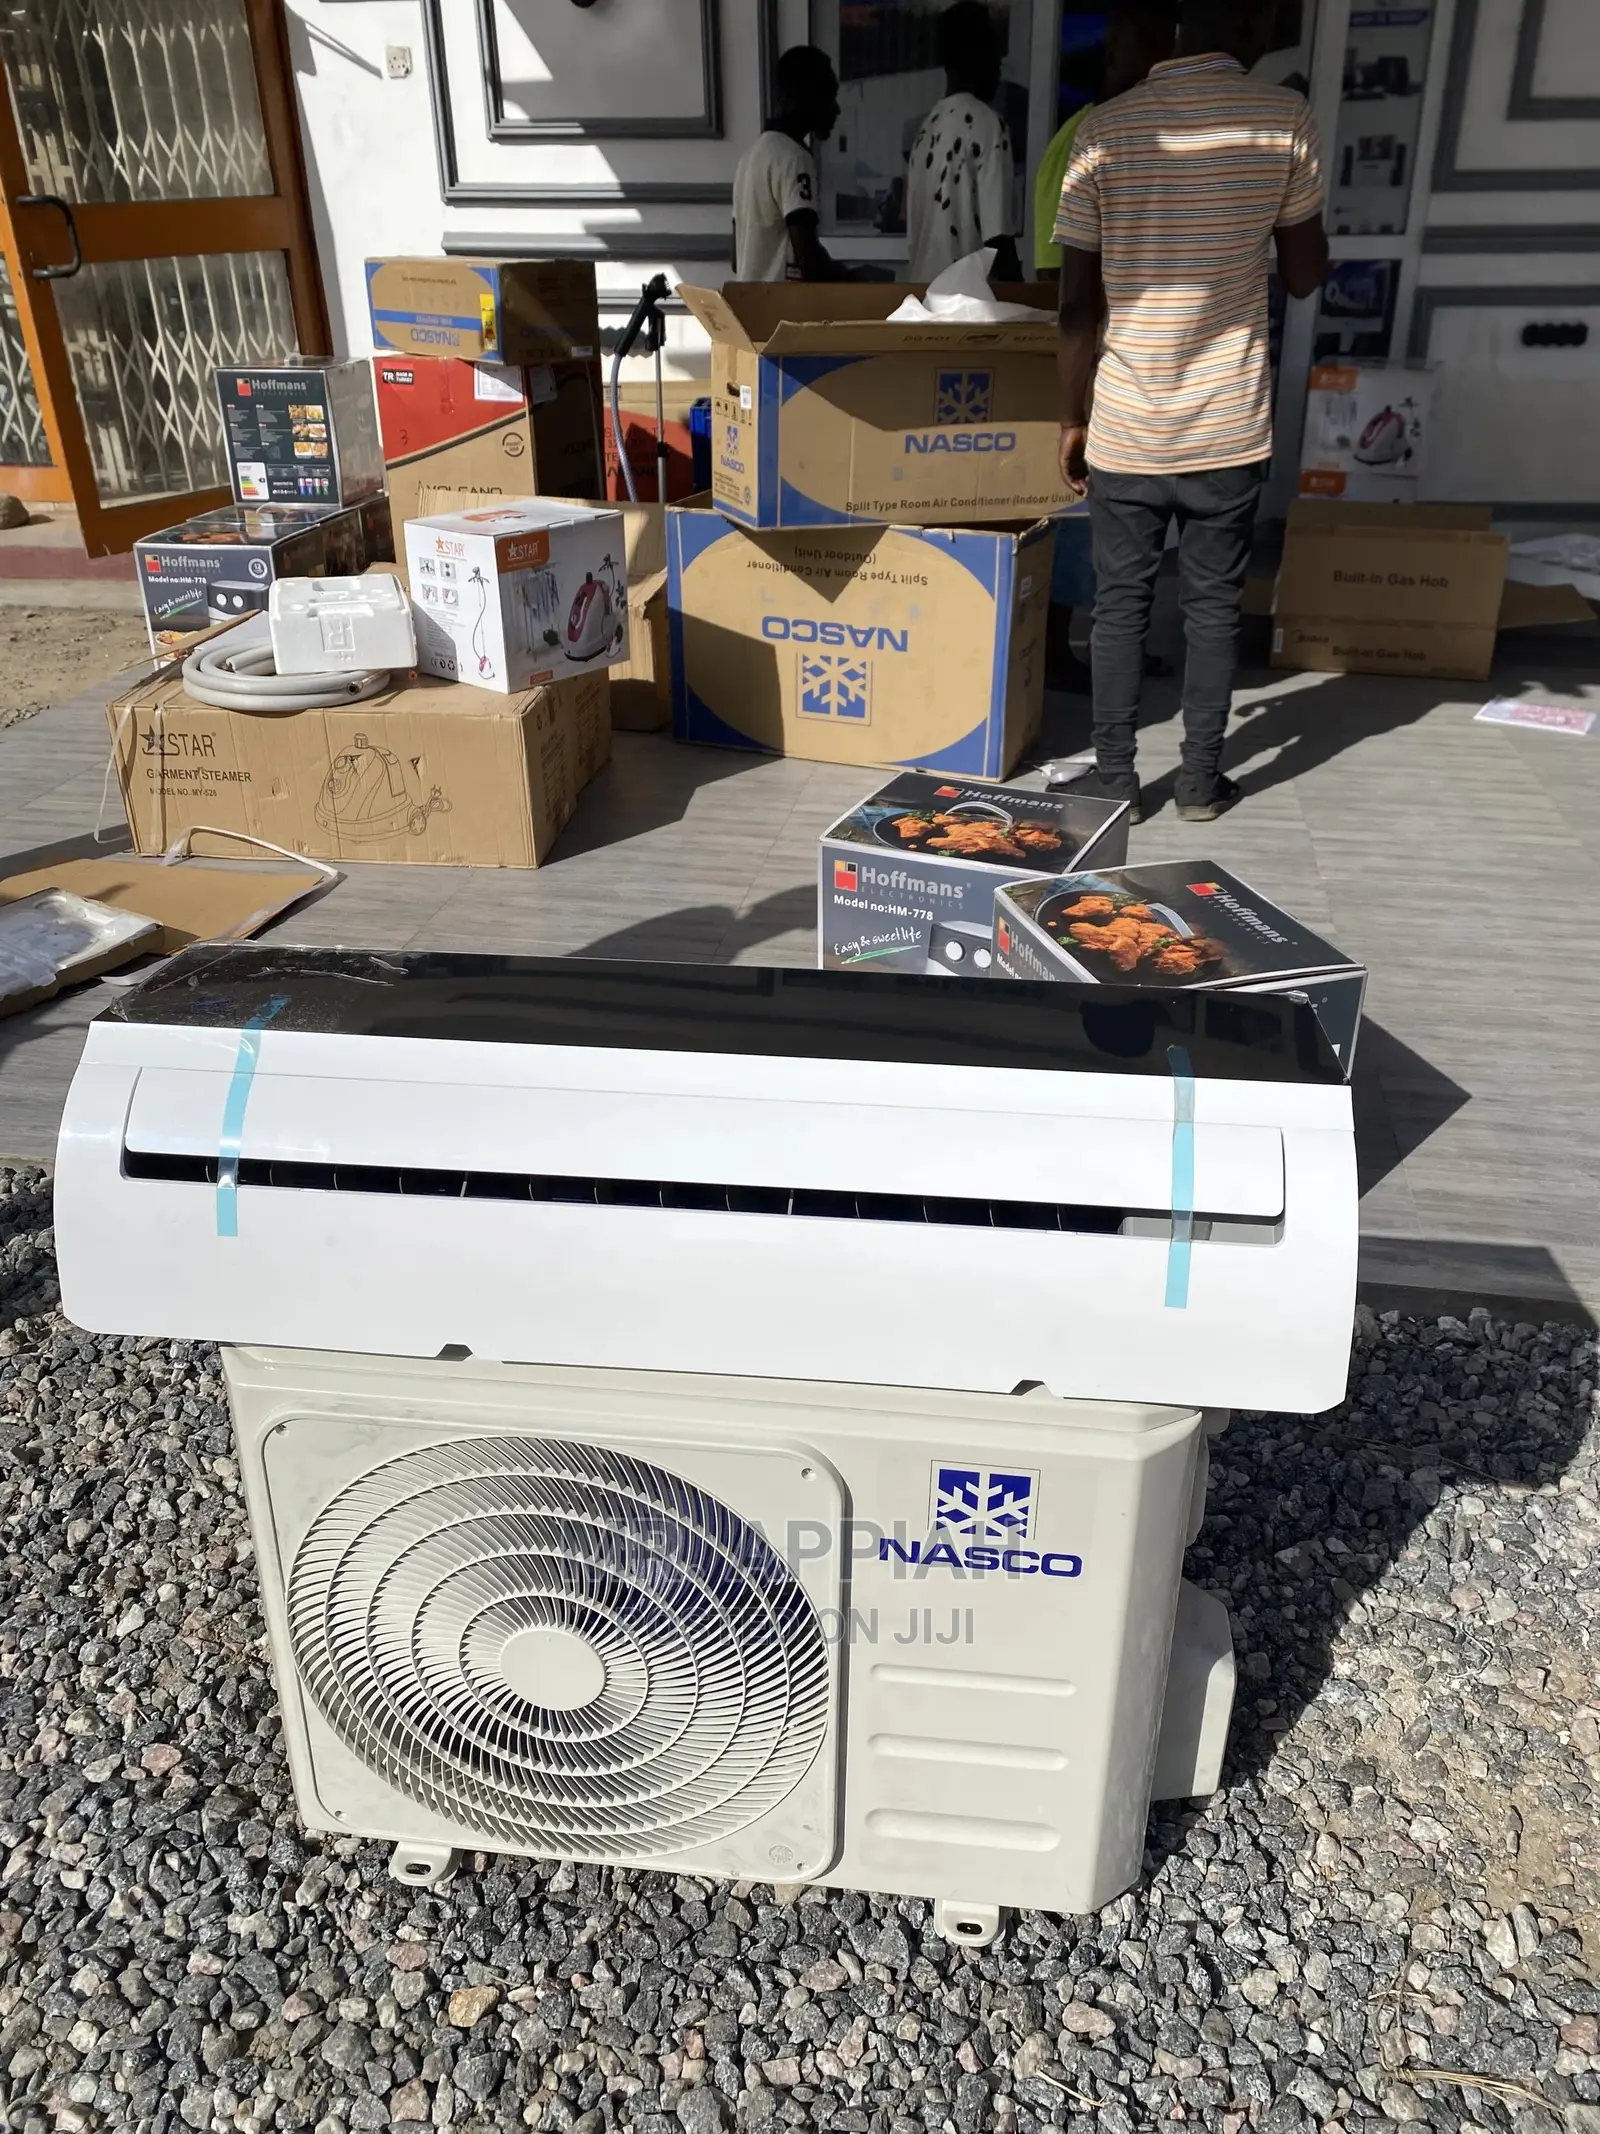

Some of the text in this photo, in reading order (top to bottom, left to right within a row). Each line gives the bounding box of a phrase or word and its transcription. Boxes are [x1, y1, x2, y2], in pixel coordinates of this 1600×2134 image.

[797, 173, 812, 201] 3
[251, 379, 307, 390] Hoffmans
[383, 371, 394, 381] TR
[904, 432, 1016, 454] NASCO
[845, 493, 1075, 512] Split Type Room Air Conditioner (Indoor Unit)
[444, 541, 464, 557] STAR
[518, 542, 539, 559] STAR
[794, 545, 876, 565] (Outdoor Unit)
[160, 555, 221, 568] Hoffmans
[747, 560, 928, 586] Split Type Room Air Conditioner
[148, 575, 169, 583] Model
[1333, 570, 1449, 588] Built-in Gas Hob
[762, 615, 908, 653] NASCO
[167, 733, 216, 757] STAR
[146, 768, 252, 782] GARMENT STEAMER
[964, 789, 1065, 809] Hoffmans
[861, 866, 964, 899] Hoffmans
[834, 894, 934, 921] Model no:HM-778
[861, 886, 963, 910] ELECTRONICS
[1213, 894, 1289, 943] Hoffmans
[834, 926, 922, 957] Easy & sweet life
[997, 953, 1015, 977] Model
[1011, 930, 1060, 981] Hoffman
[879, 1537, 1083, 1578] NASCO
